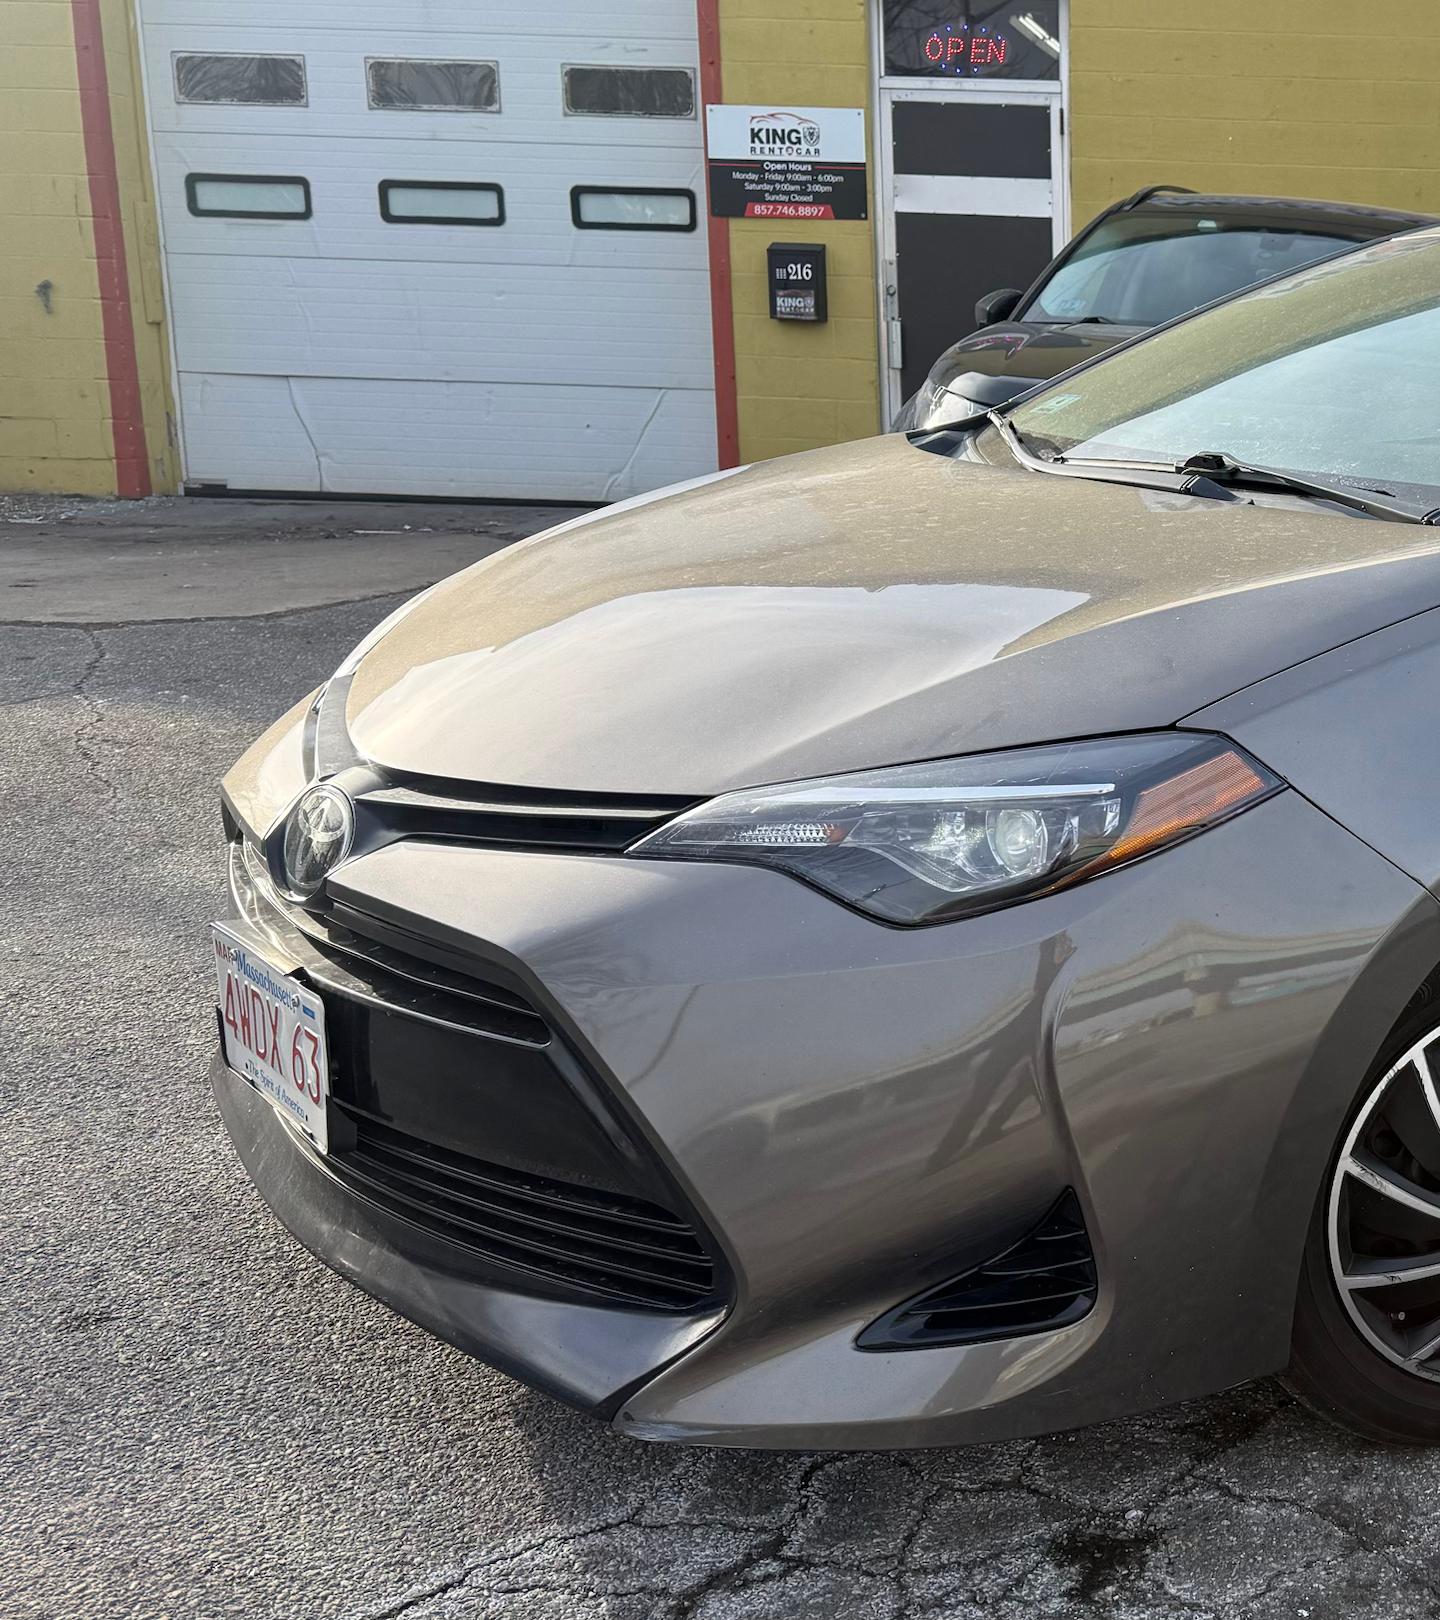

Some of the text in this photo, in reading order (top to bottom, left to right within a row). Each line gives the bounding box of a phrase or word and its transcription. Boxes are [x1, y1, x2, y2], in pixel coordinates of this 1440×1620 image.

[925, 36, 1007, 64] OPEN
[750, 127, 802, 145] KING
[763, 161, 812, 171] Open Hours
[732, 171, 759, 181] Monday
[764, 172, 785, 182] Friday
[786, 173, 812, 181] 9:00am
[817, 174, 844, 183] 6:00pm
[744, 181, 774, 192] Saturday
[775, 182, 800, 191] 9:00am
[806, 184, 832, 193] 3:00pm
[764, 192, 813, 202] Sunday Closed
[754, 204, 825, 217] 857.746.8897
[787, 263, 812, 280] 216
[776, 296, 804, 307] KING
[237, 949, 297, 1013] Massachusett
